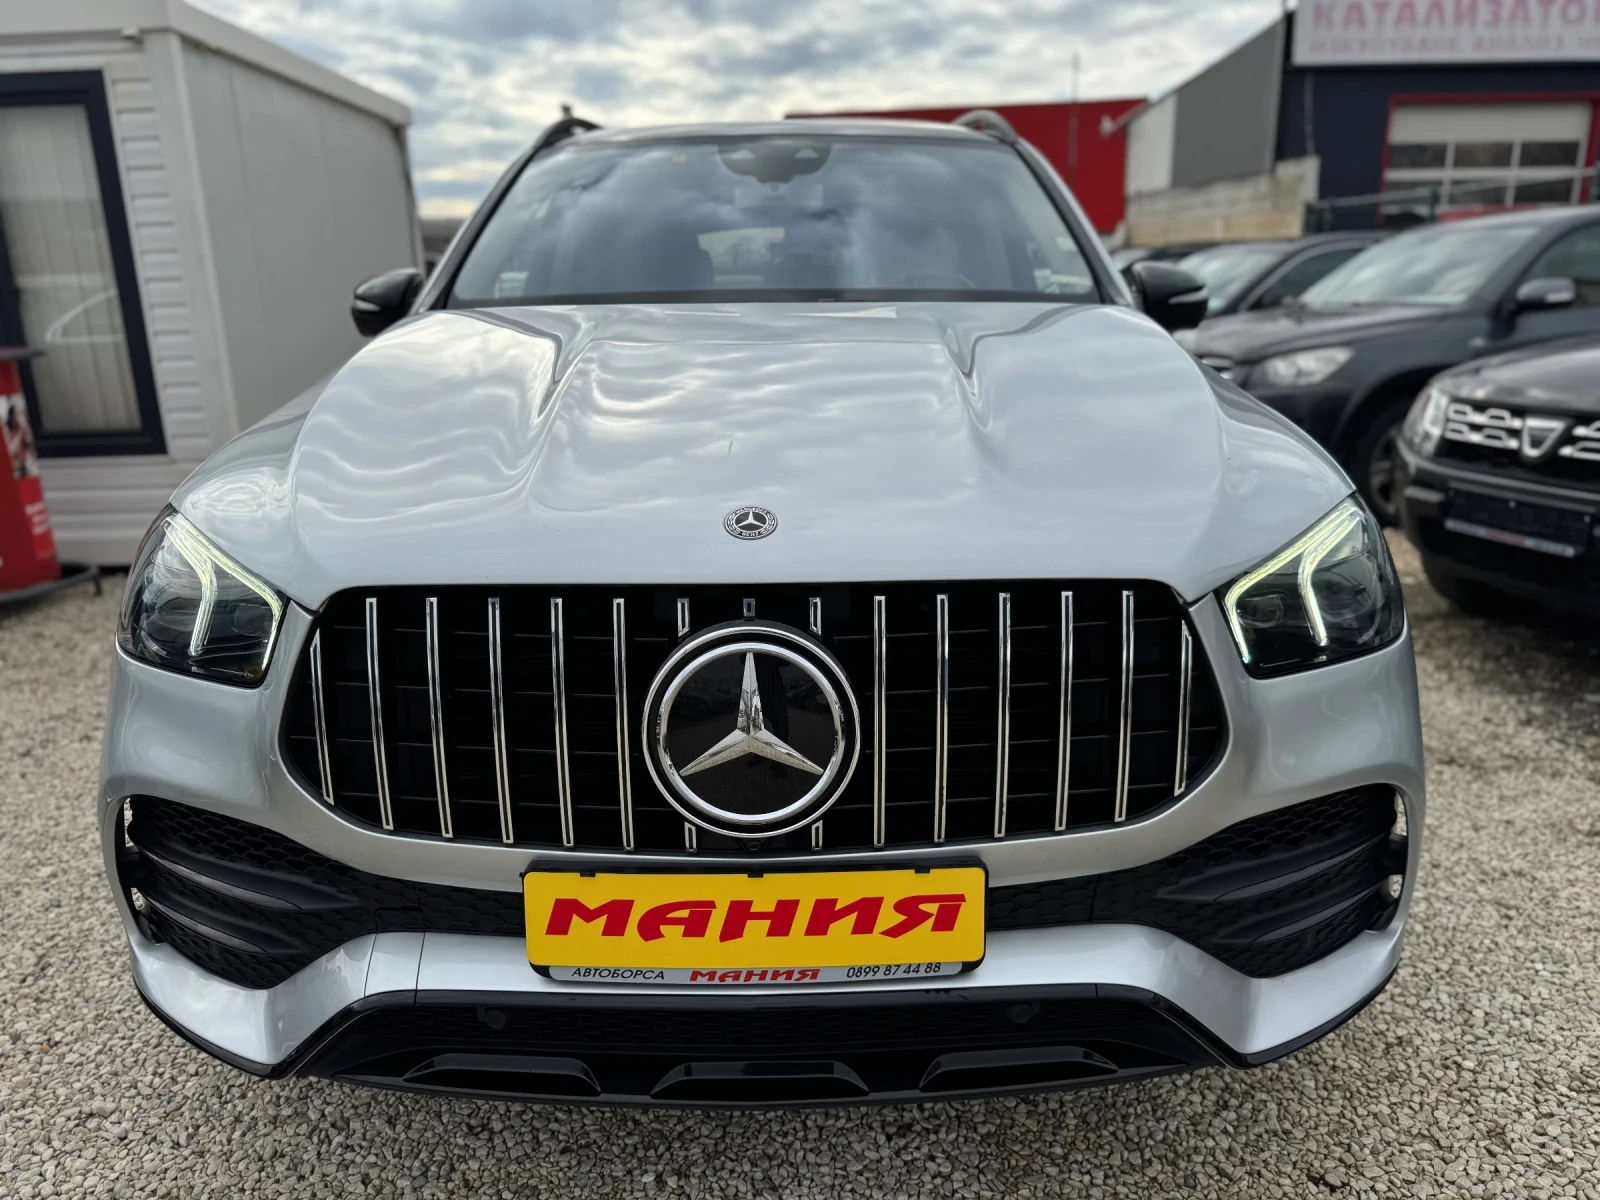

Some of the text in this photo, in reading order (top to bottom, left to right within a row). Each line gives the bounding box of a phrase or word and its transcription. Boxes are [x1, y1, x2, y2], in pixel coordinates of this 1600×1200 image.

[545, 893, 966, 943] МАНИЯ
[571, 961, 942, 983] АВТОБОРСА МАНИЯ 0899 87 44 88
